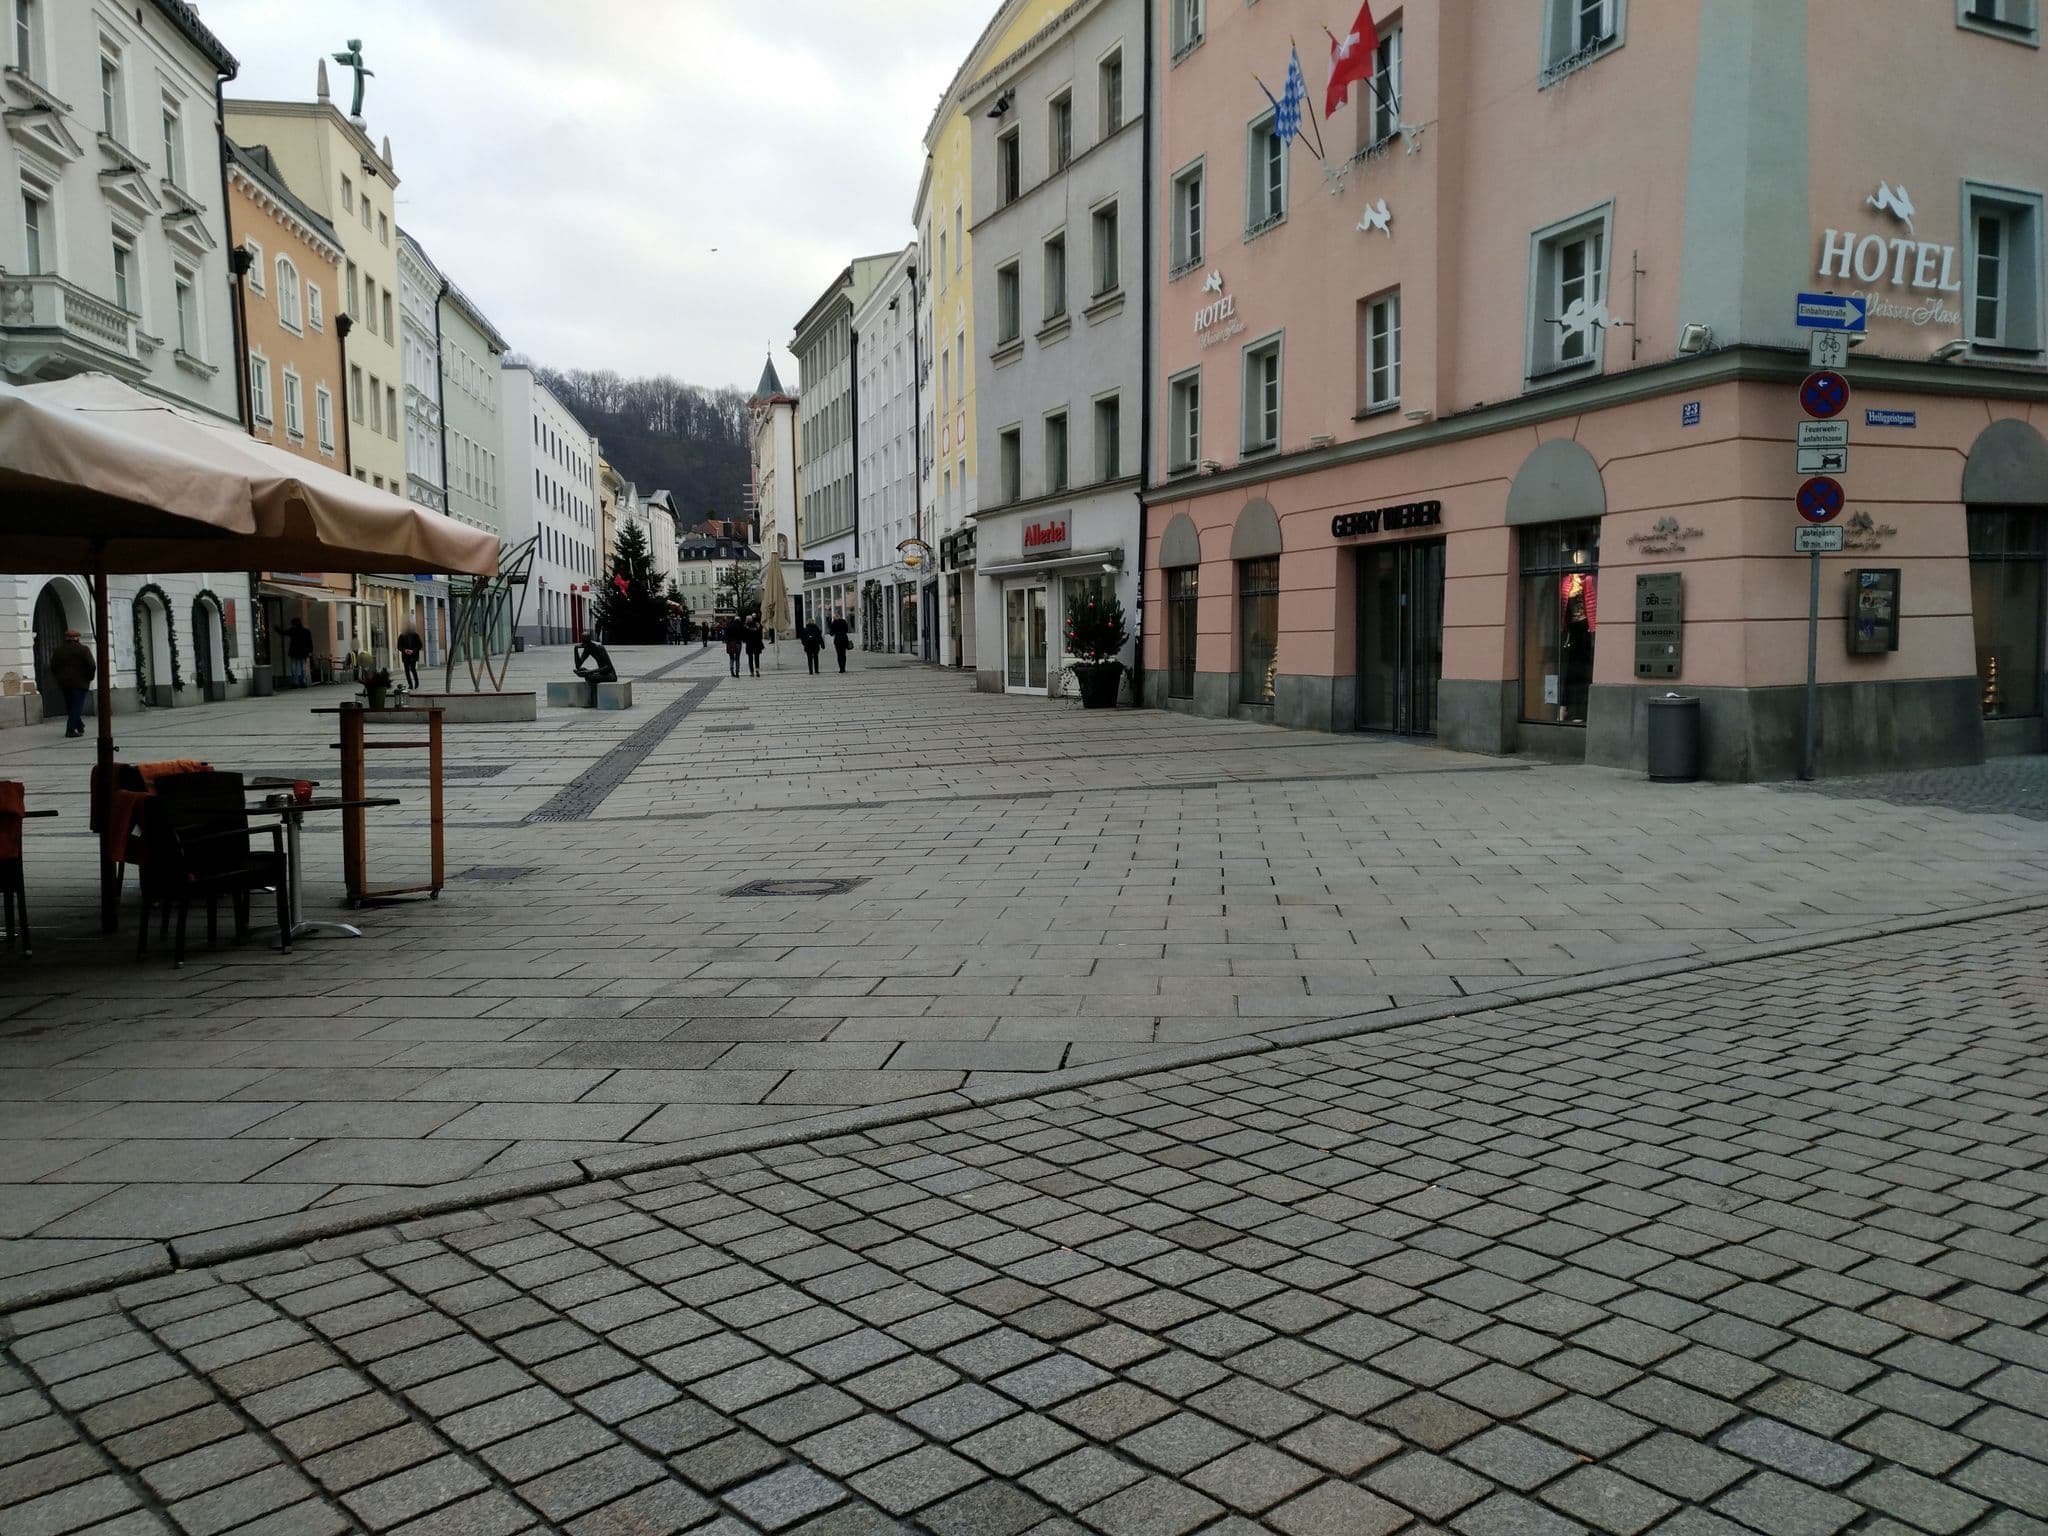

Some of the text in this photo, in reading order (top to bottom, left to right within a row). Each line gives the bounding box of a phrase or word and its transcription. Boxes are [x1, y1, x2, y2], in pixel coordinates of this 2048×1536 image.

[1819, 228, 1961, 292] HOTEL
[1193, 294, 1235, 332] HOTEL
[1799, 305, 1847, 319] Einbahnstraße
[1911, 297, 1962, 326] Hase
[1684, 403, 1698, 416] 23
[1331, 499, 1441, 538] GERRY WEBER
[1024, 521, 1066, 547] Allerlei
